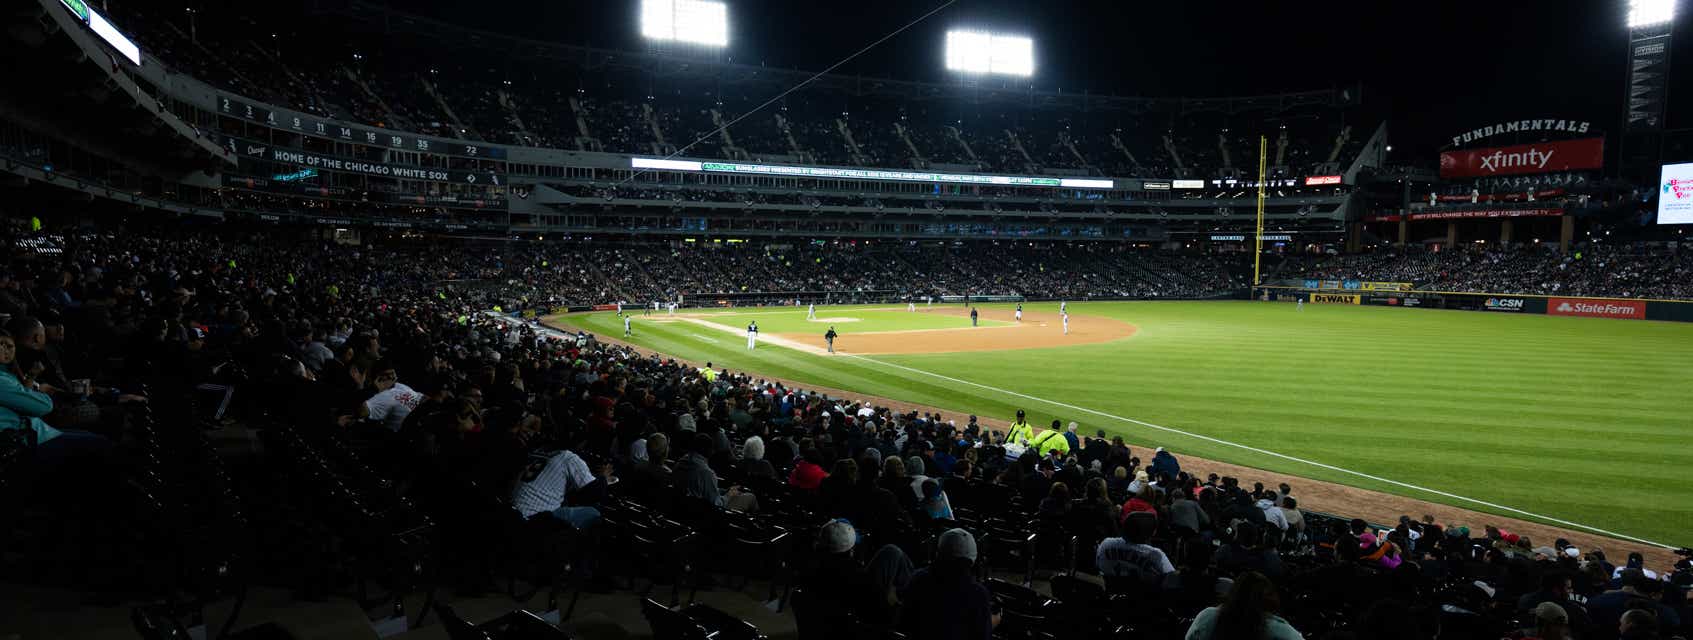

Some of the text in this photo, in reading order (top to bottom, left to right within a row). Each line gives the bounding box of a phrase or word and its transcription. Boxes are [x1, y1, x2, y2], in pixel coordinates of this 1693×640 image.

[223, 98, 230, 109] 2
[341, 127, 351, 137] 14
[392, 136, 402, 145] 19
[417, 139, 428, 149] 35
[465, 146, 477, 154] 72
[1453, 119, 1590, 146] FUNDAMENTALS
[274, 150, 448, 181] HOME OF THE CHICAGO WHITE SOX
[1480, 148, 1554, 172] xfinity
[1499, 299, 1524, 308] CSN
